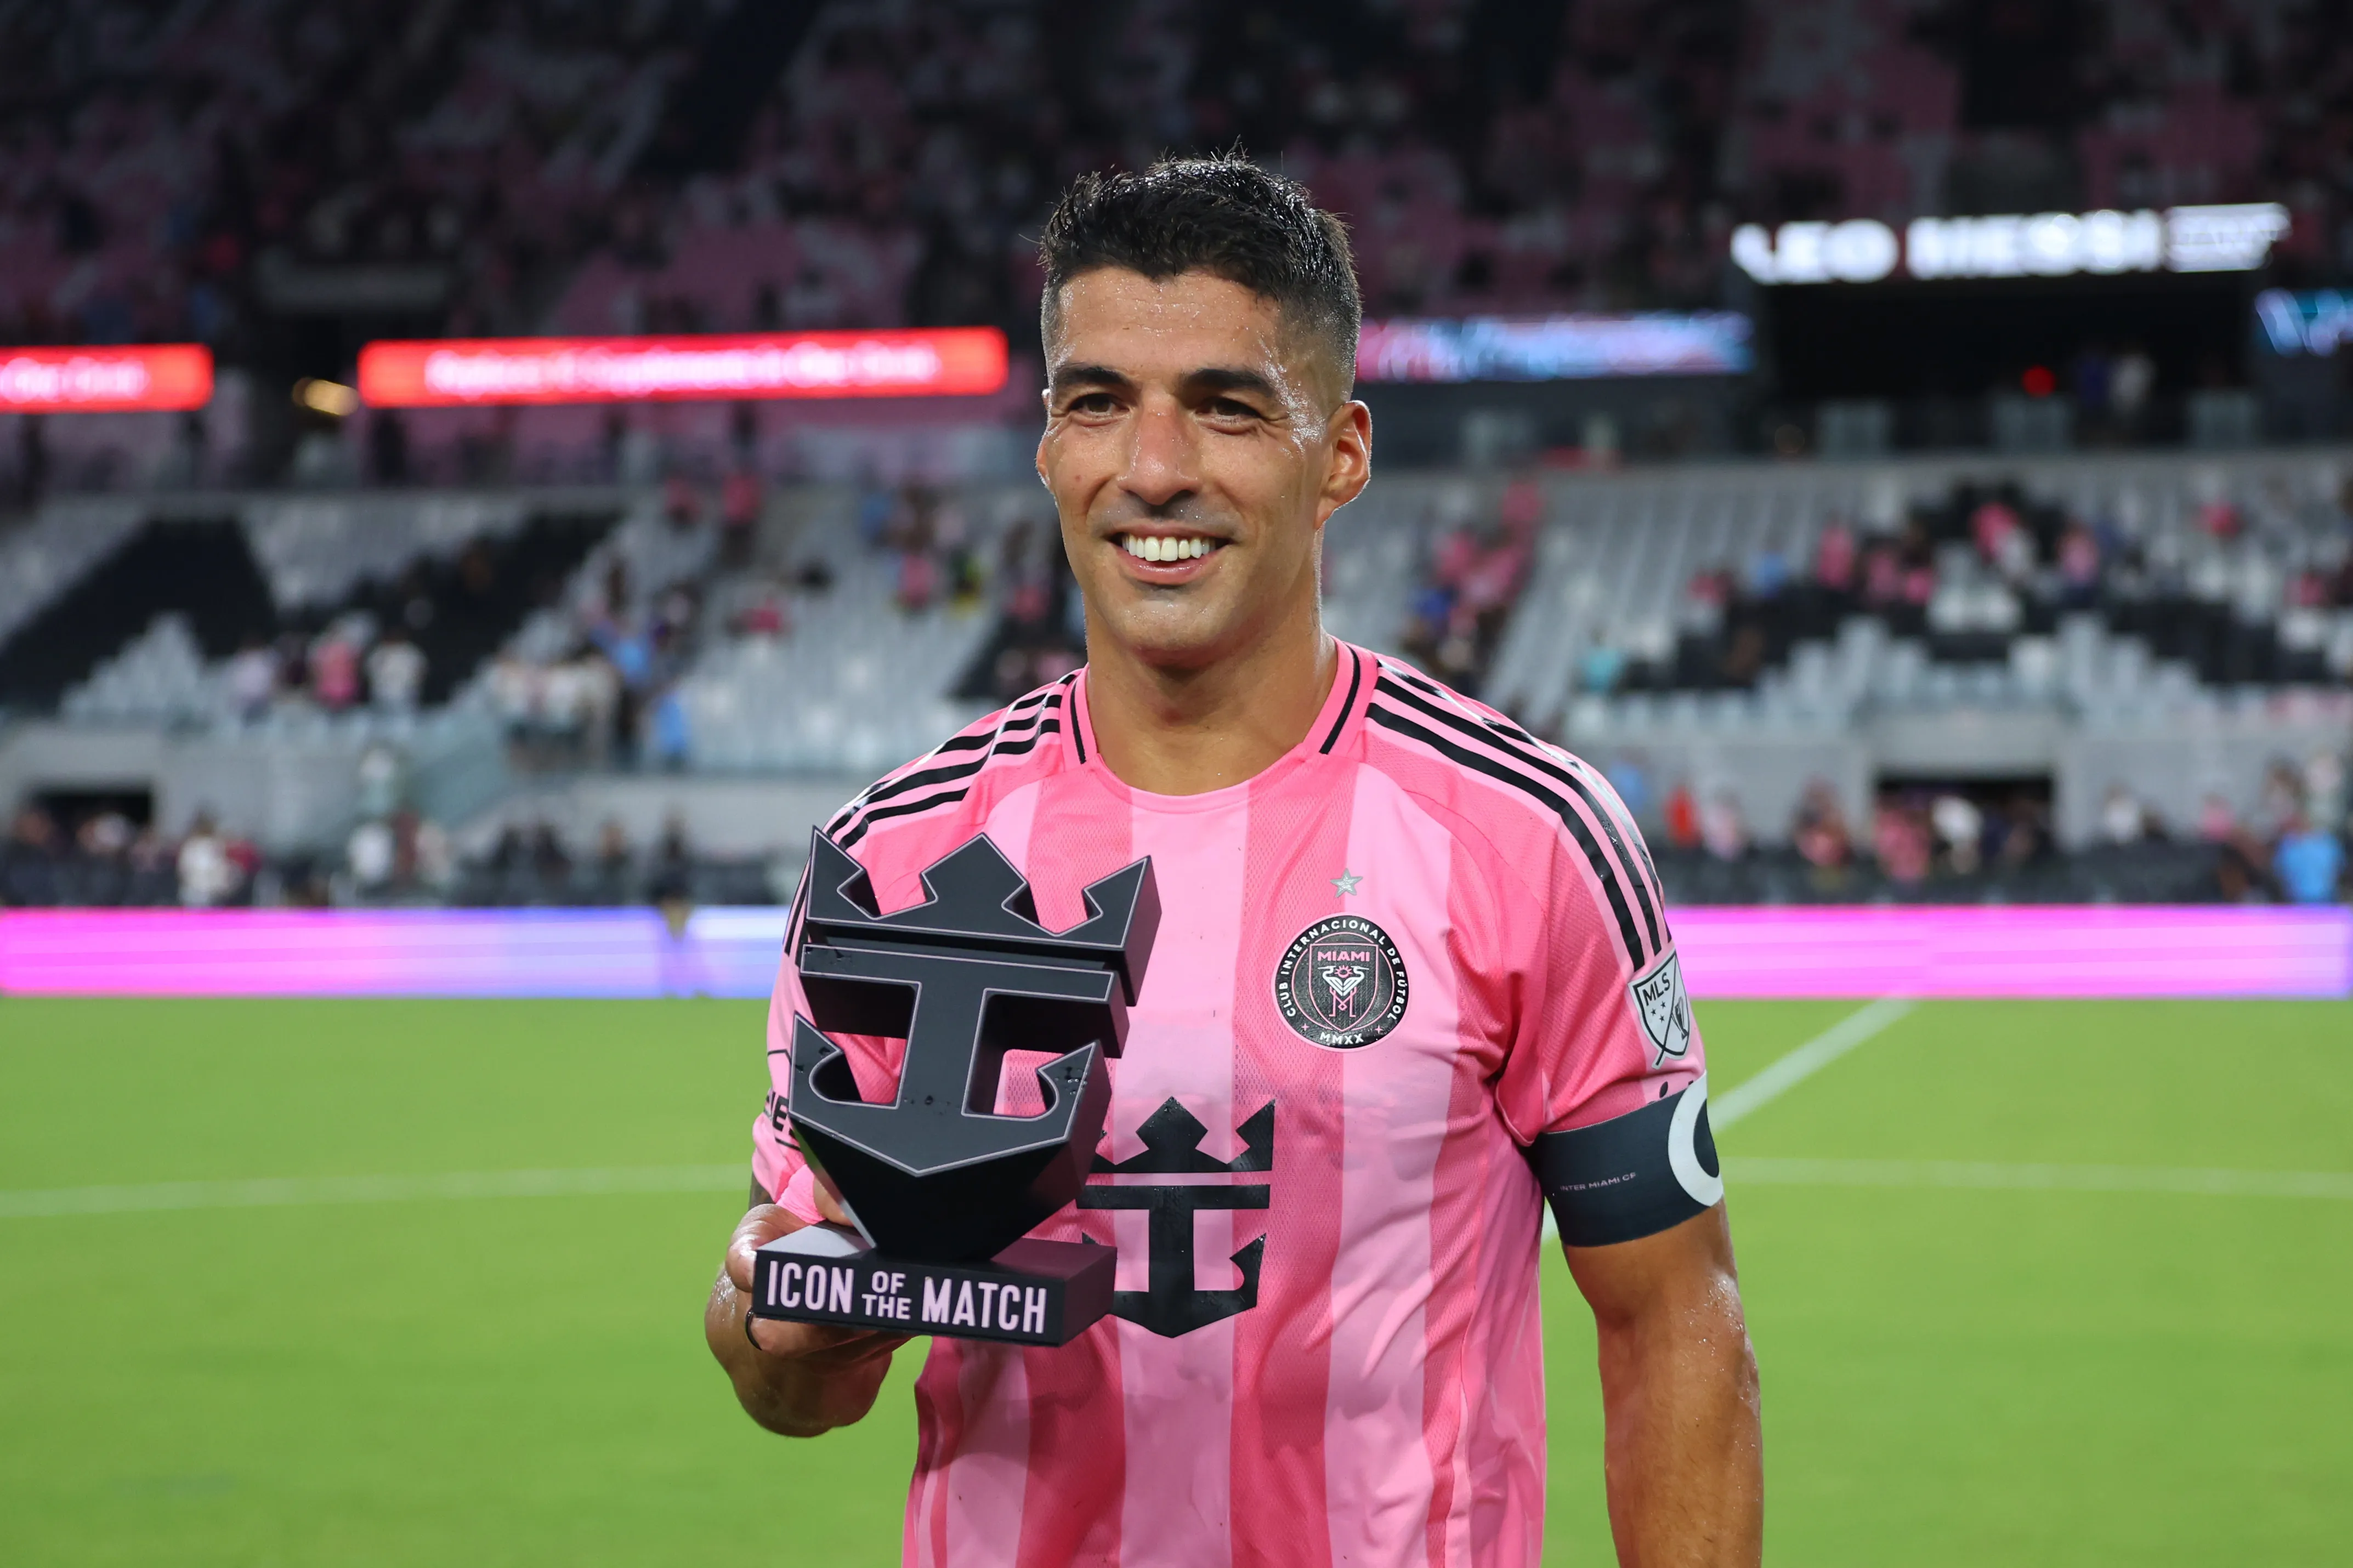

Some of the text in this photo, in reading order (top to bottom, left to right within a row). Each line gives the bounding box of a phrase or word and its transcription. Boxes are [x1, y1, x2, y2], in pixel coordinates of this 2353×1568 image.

[1317, 951, 1370, 961] MIAMI
[1278, 919, 1408, 1020] CLUB INTERNACIONAL DE FÚTBOL
[1642, 972, 1670, 1007] MLS
[1319, 1032, 1365, 1044] MMXX
[1588, 1177, 1620, 1189] MIAMI
[1622, 1172, 1636, 1181] CF
[767, 1260, 1047, 1334] ICON OF THE MATCH
